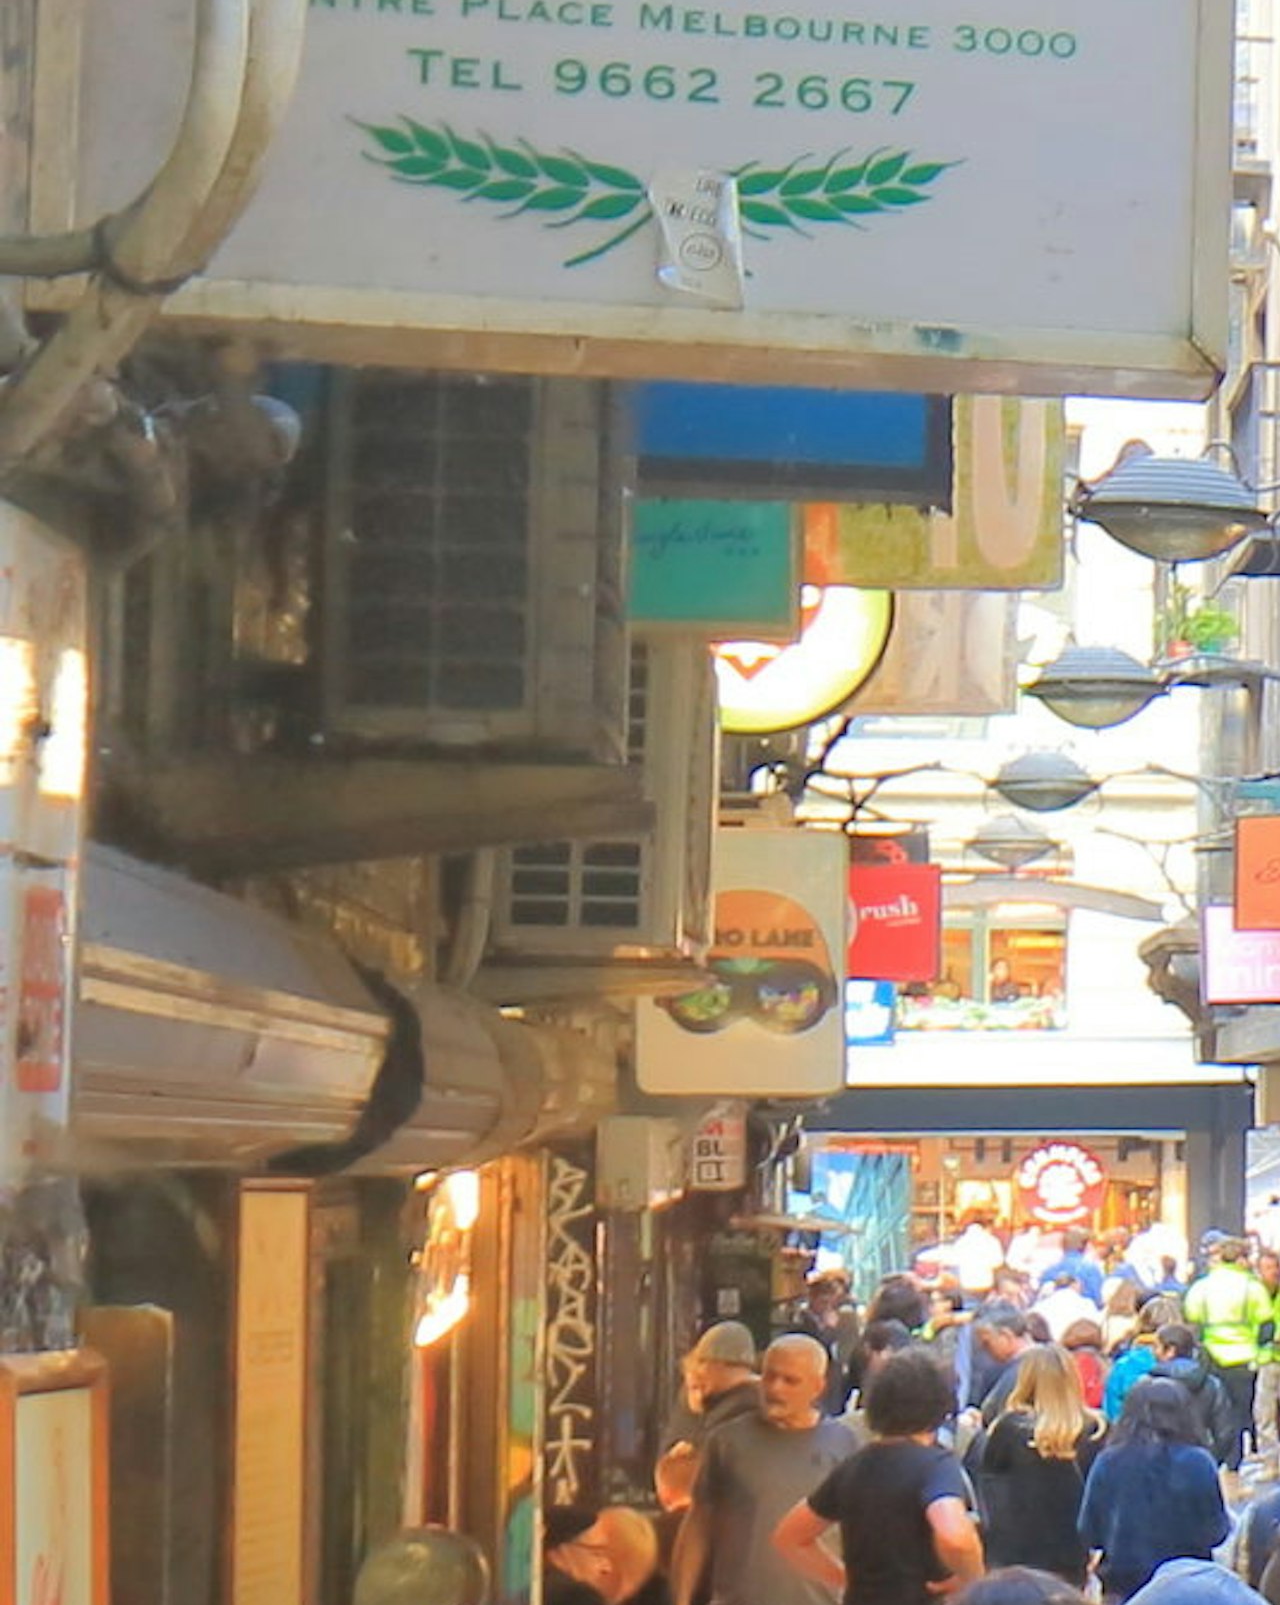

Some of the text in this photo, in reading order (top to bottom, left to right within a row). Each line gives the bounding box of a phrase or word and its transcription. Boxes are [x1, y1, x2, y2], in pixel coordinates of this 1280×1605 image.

[953, 24, 1078, 59] 3000
[555, 58, 720, 104] 9662
[753, 72, 915, 115] 2667
